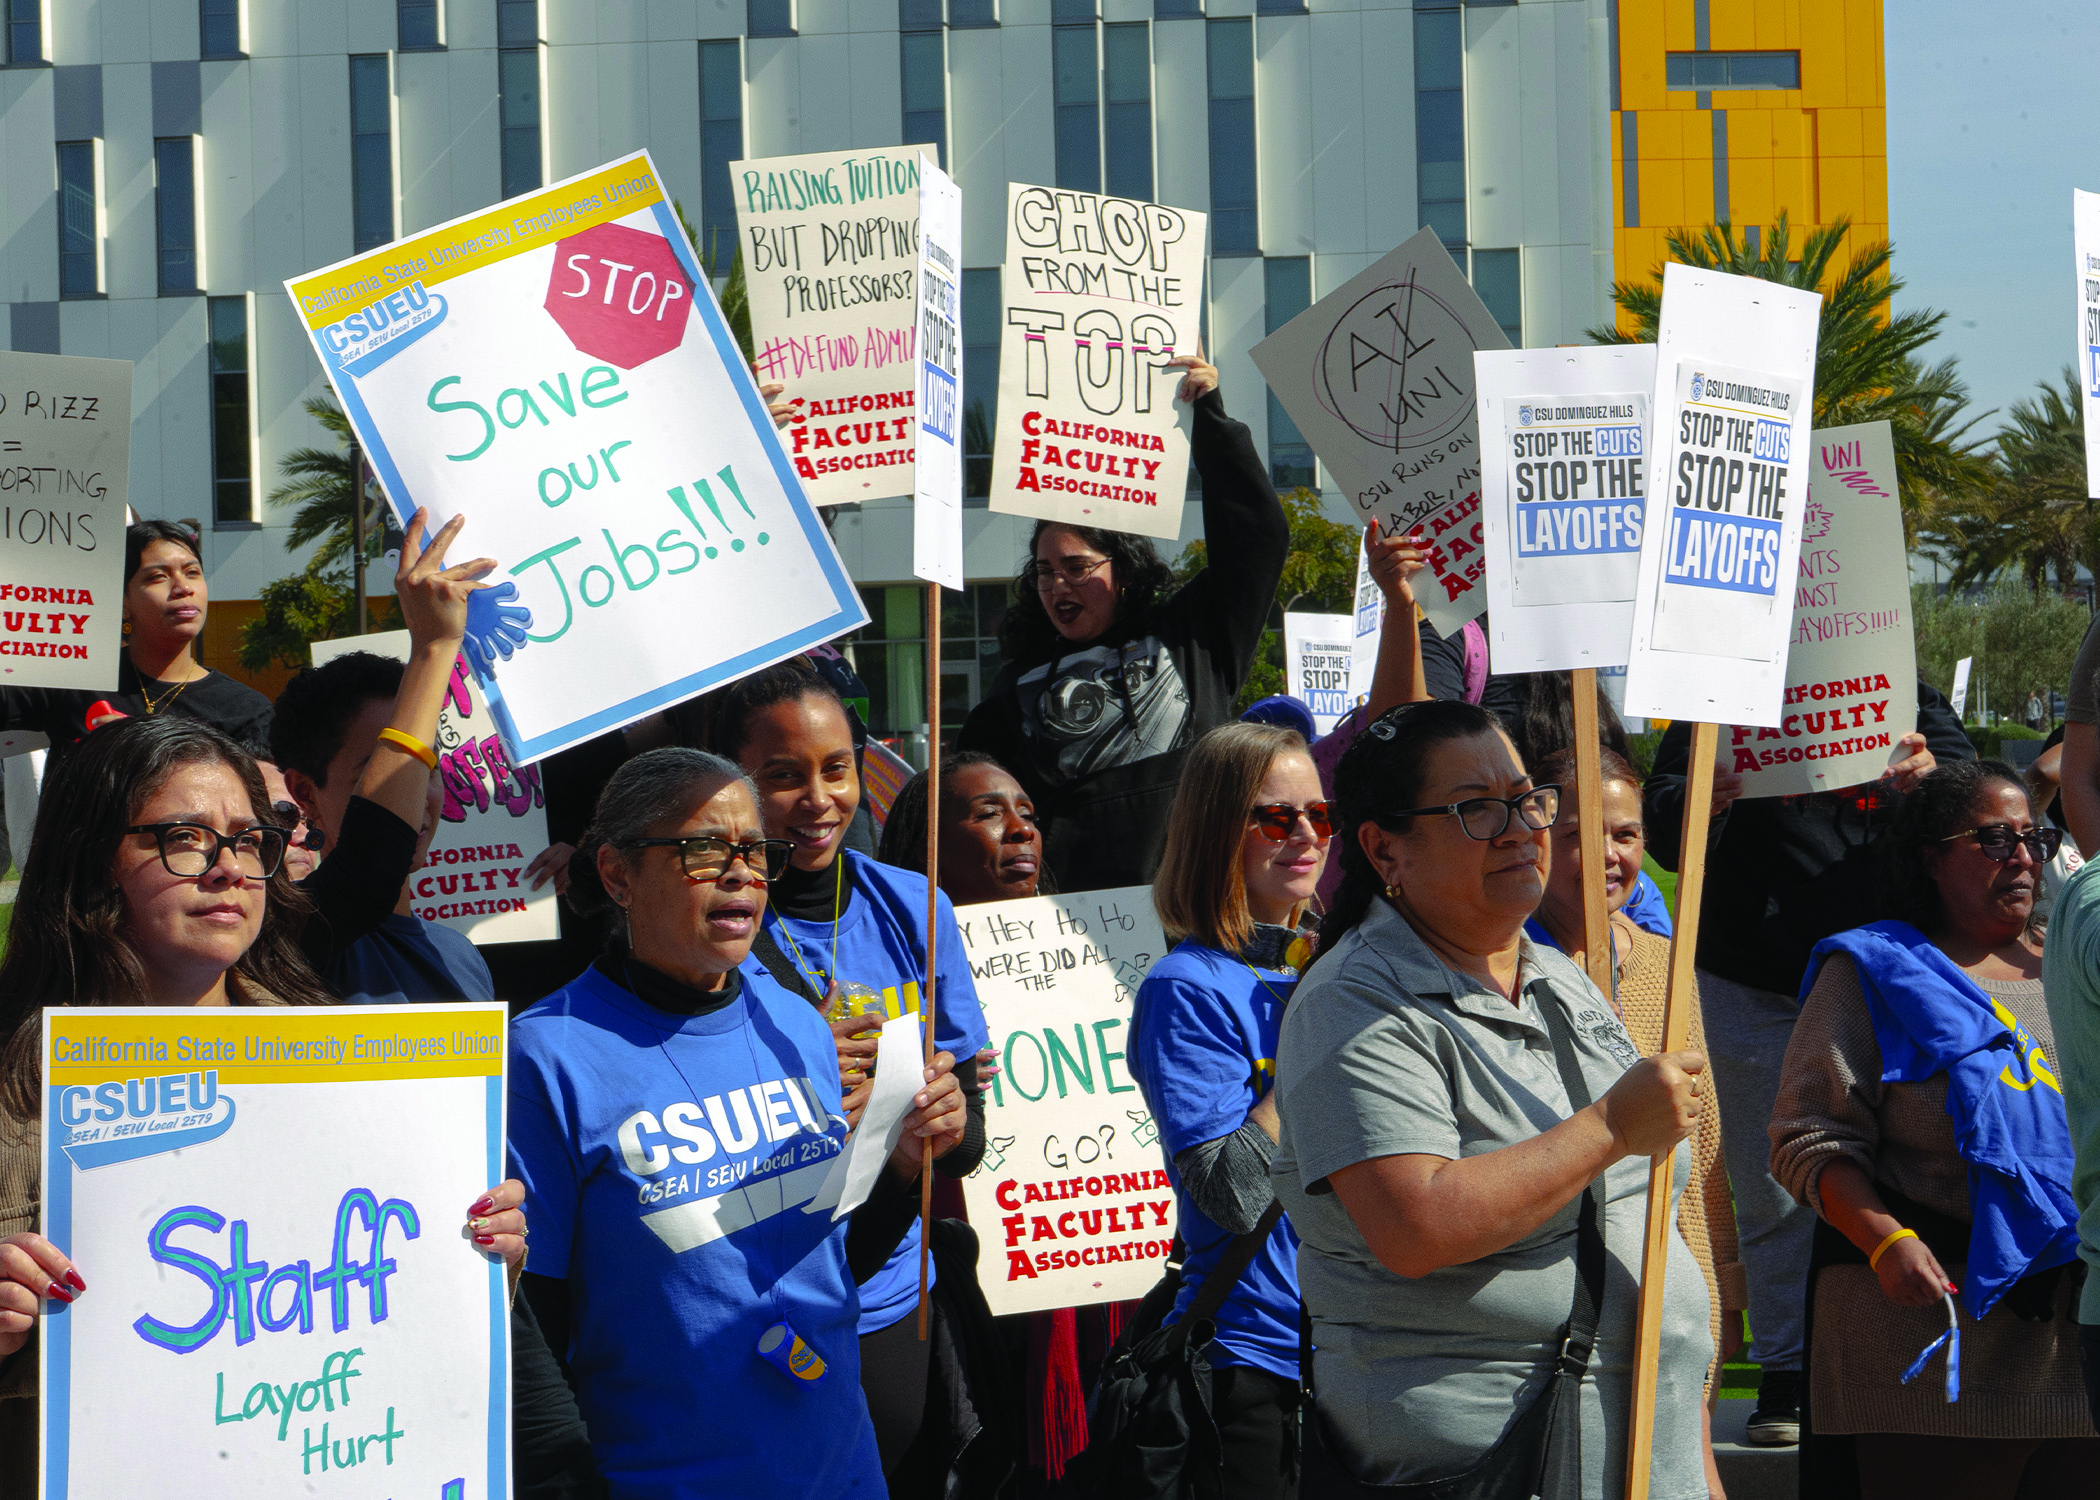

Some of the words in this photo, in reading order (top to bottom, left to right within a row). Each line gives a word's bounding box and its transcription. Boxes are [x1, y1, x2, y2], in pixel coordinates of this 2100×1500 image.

[743, 167, 843, 213] RAISING
[842, 156, 919, 204] TUITION
[301, 275, 383, 314] California
[382, 256, 428, 284] State
[428, 225, 511, 266] University
[511, 193, 602, 237] Employees
[602, 173, 655, 203] Union
[750, 224, 806, 272] BUT
[1015, 187, 1185, 272] CHOP
[562, 254, 683, 322] STOP
[783, 270, 913, 318] PROFESSORS?
[1022, 256, 1110, 298] FROM
[1112, 267, 1183, 306] THE
[323, 281, 430, 352] CSUEU
[338, 347, 361, 366] CSEA
[368, 332, 389, 349] SEIU
[390, 320, 410, 337] Local
[411, 308, 432, 326] 2579
[925, 307, 943, 366] STOP
[757, 334, 859, 380] #DEFUND
[1008, 307, 1176, 416] TOP
[1350, 302, 1435, 392] AI
[25, 391, 99, 420] RIZZ
[427, 365, 629, 462] Save
[788, 390, 914, 424] CALIFORNI
[924, 368, 955, 439] LAYOFFS
[1379, 366, 1463, 425] UNI
[1535, 407, 1553, 421] CSU
[1555, 406, 1608, 420] DOMINGUEZ
[1609, 404, 1633, 418] HILLS
[1705, 379, 1724, 399] CSU
[1725, 382, 1770, 408] DOMINGUEZ
[1770, 391, 1790, 411] HILLS
[1021, 410, 1165, 452] CALIFORNIA
[1513, 432, 1558, 458] STOP
[1561, 431, 1593, 456] THE
[1596, 428, 1641, 455] CUTS
[1680, 409, 1723, 448] STOP
[1726, 417, 1754, 454] THE
[1755, 421, 1790, 462] CUTS
[538, 440, 632, 508] our
[794, 448, 914, 480] ASSOCIATIO
[1020, 438, 1162, 481] FACULTY
[1358, 479, 1393, 511] CSU
[1391, 449, 1445, 484] RUNS
[1448, 433, 1473, 454] ON
[1821, 440, 1861, 471] UNI
[0, 466, 107, 501] ORTING
[1015, 466, 1157, 506] ASSOCIATION
[1516, 460, 1587, 502] STOP
[1592, 458, 1643, 498] THE
[1676, 451, 1744, 513] STOP
[1747, 462, 1787, 520] THE
[6, 507, 96, 551] IONS
[1409, 488, 1481, 549] CALIF
[1519, 504, 1642, 552] LAYOFFS
[508, 464, 770, 643] Jobs!!!
[1668, 516, 1779, 589] LAYOFFS
[0, 584, 94, 605] FORNIA
[1794, 582, 1838, 609] INST
[0, 611, 90, 634] ULTY
[1790, 608, 1900, 644] AYOFFS!!!!!
[0, 640, 88, 659] CIATION
[1302, 655, 1326, 668] STOP
[1328, 656, 1344, 669] THE
[1303, 669, 1341, 689] STOP
[1783, 673, 1891, 705] IFORNIA
[1732, 732, 1891, 773] ASSOCIATION
[422, 843, 524, 867] FORNIA
[987, 913, 1035, 945] HEY
[969, 951, 1032, 979] WERE
[1039, 947, 1076, 972] DID
[1082, 944, 1117, 965] ALL
[1015, 974, 1056, 991] THE
[54, 1036, 168, 1062] California
[176, 1036, 236, 1061] State
[244, 1035, 347, 1065] University
[353, 1033, 446, 1063] Employees
[452, 1030, 500, 1055] Union
[984, 1018, 1135, 1107] ONE
[62, 1070, 217, 1126] CSUEU
[64, 1127, 100, 1145] CSEA
[112, 1121, 145, 1137] SEIU
[147, 1116, 179, 1132] Local
[181, 1112, 213, 1127] 2579
[617, 1077, 830, 1176] CSUEU
[1044, 1124, 1115, 1170] GO?
[638, 1173, 689, 1205] CSEA
[706, 1159, 747, 1189] SEIU
[752, 1150, 795, 1176] Local
[995, 1169, 1171, 1211] CALIFORNIA
[1002, 1200, 1171, 1247] FACULTY
[132, 1187, 420, 1355] Staff
[1006, 1238, 1174, 1281] ASSOCIATION
[215, 1347, 366, 1441] Layoff
[300, 1406, 404, 1475] Hurt
